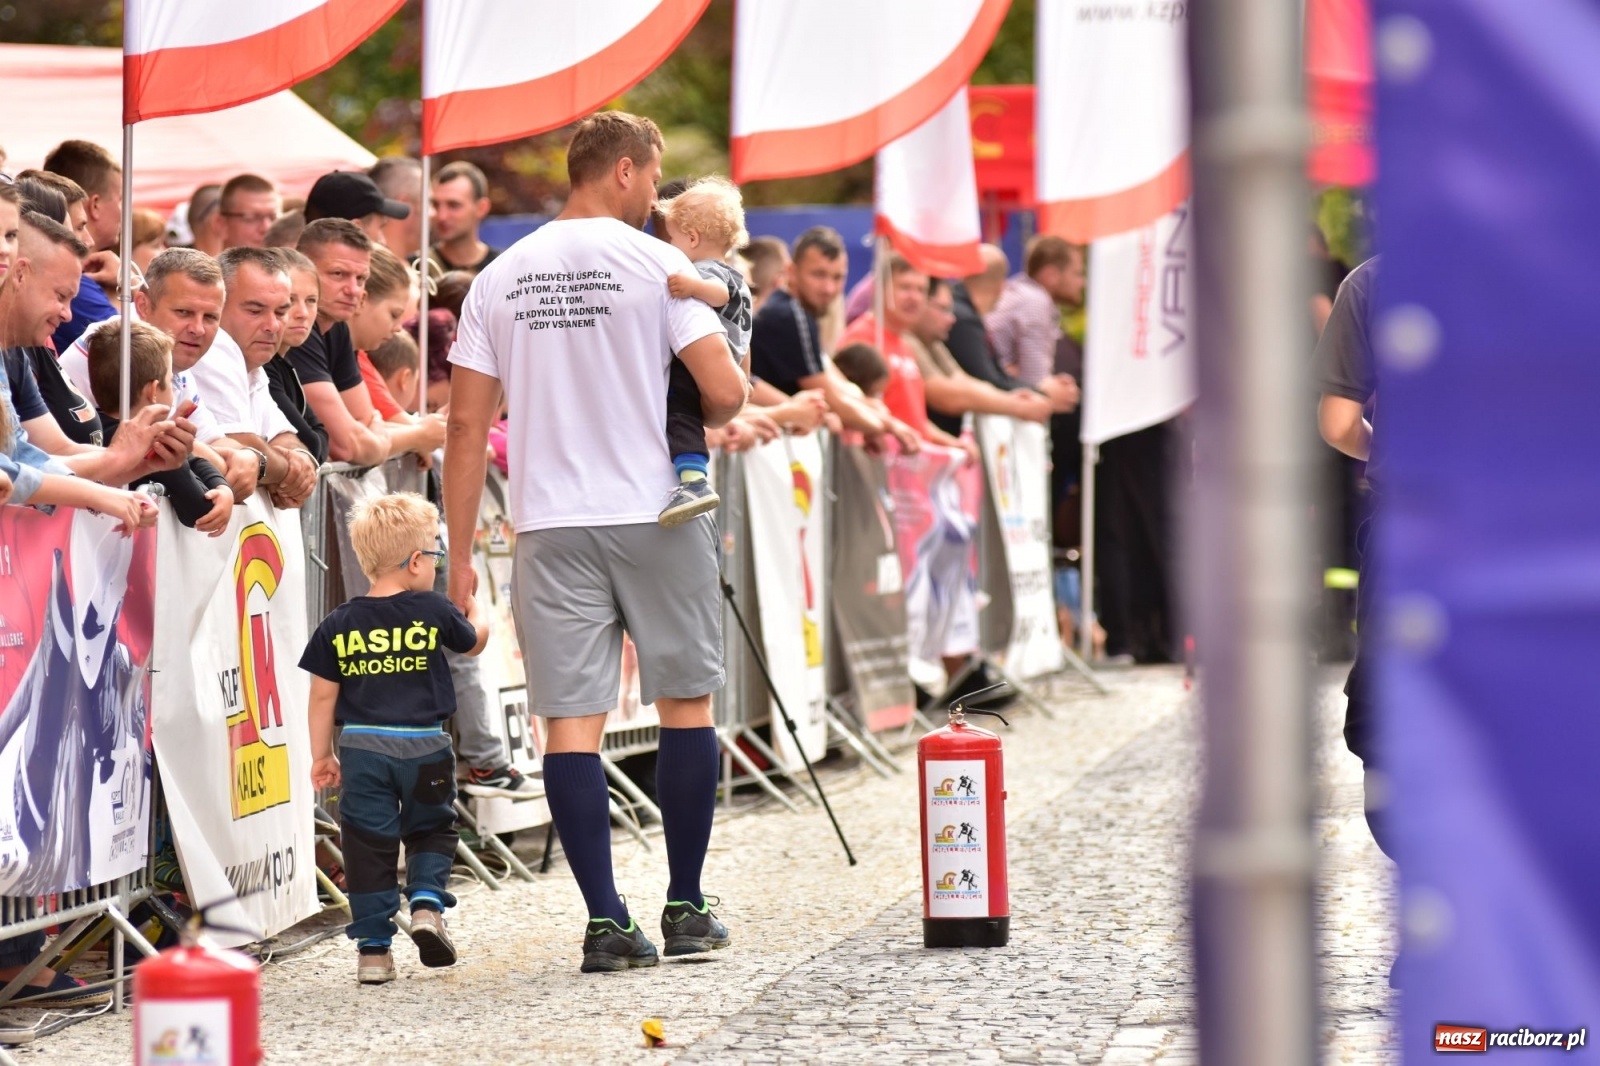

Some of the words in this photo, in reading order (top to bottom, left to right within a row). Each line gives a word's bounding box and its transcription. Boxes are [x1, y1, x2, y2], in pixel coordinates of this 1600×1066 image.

[516, 273, 533, 286] NÁŠ
[534, 271, 575, 283] NEJVĚTŠÍ
[576, 269, 612, 281] ÚSPĚCH
[524, 286, 531, 295] V
[531, 284, 555, 295] TOM,
[555, 282, 568, 294] ŽE
[568, 281, 625, 293] NEPADNEME,
[539, 296, 557, 305] ALE
[557, 296, 564, 305] V
[564, 295, 586, 305] TOM,
[514, 309, 526, 321] ŽE
[526, 307, 567, 319] KDYKOLIV
[568, 306, 613, 317] PADNEME,
[529, 319, 551, 330] VŽDY
[551, 318, 596, 329] VSTANEME
[338, 655, 428, 677] ŽAROŠICE
